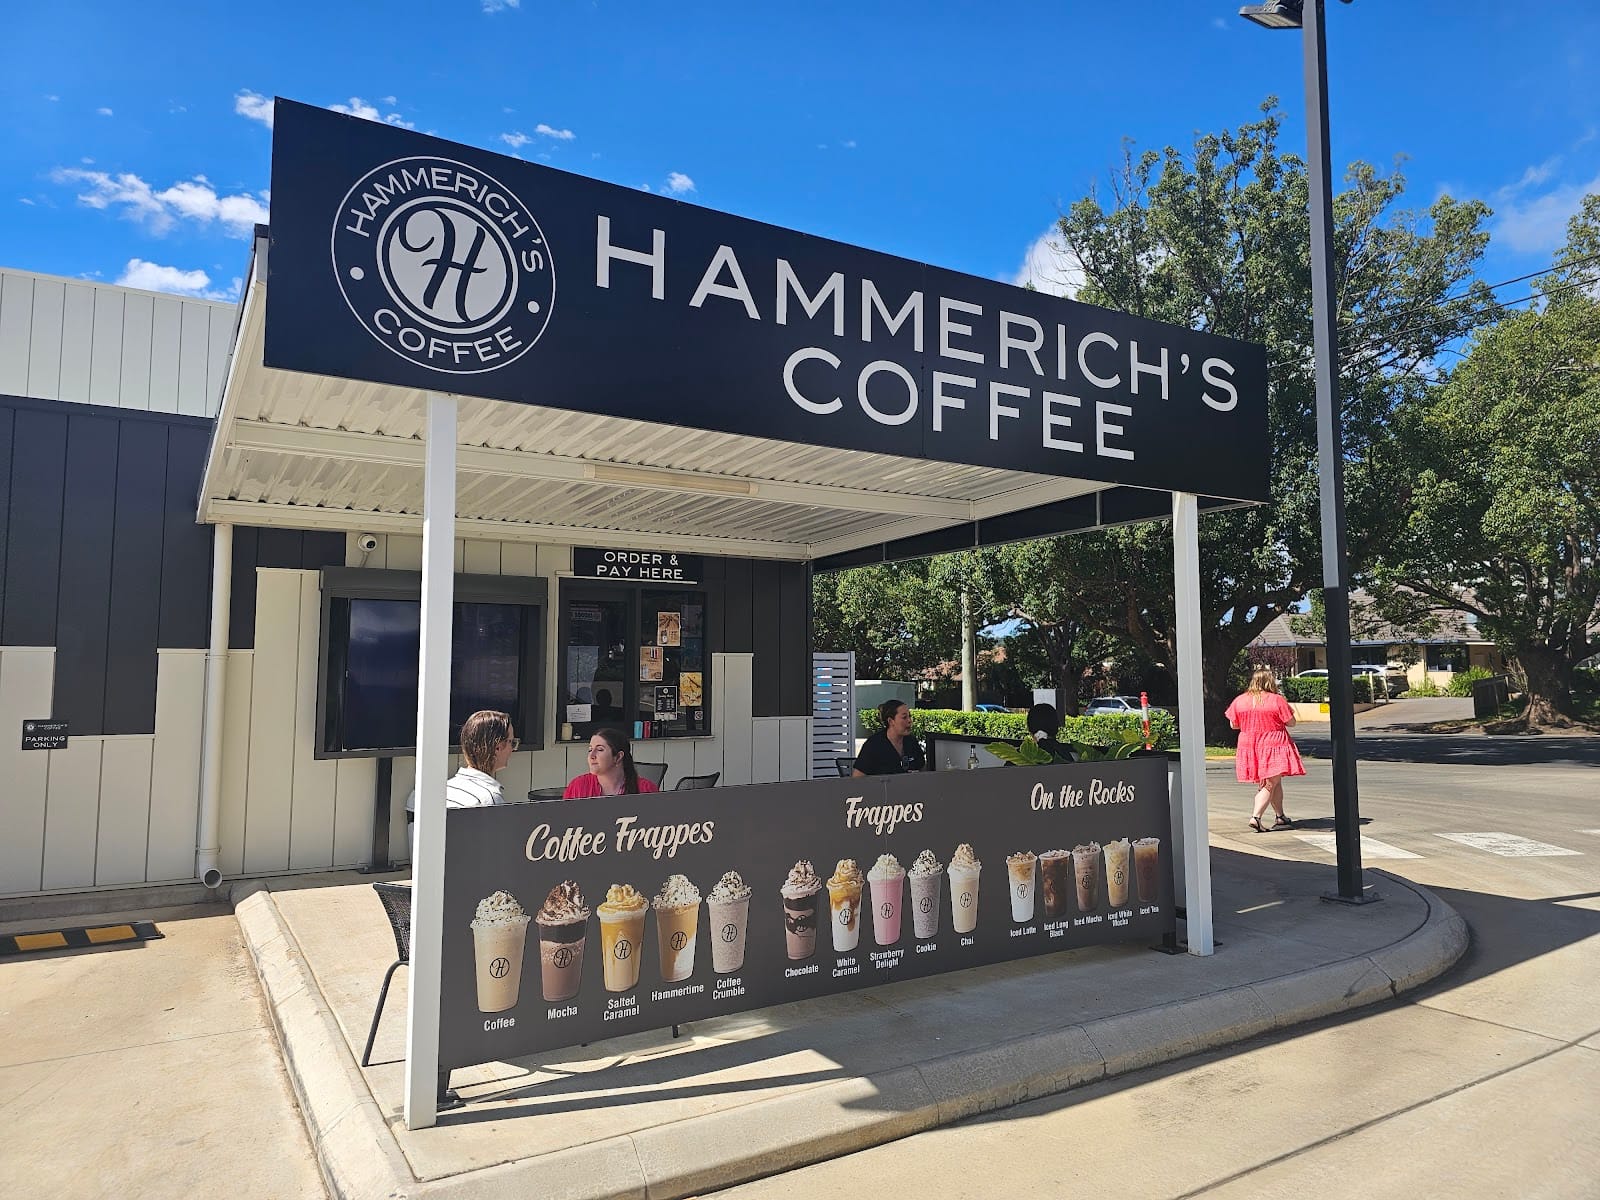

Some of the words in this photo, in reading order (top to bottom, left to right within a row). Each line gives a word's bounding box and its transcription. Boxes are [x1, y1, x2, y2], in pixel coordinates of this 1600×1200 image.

[346, 167, 544, 273] HAMMERICH'S
[596, 214, 1239, 412] HAMMERICH'S
[373, 308, 523, 364] COFFEE
[781, 346, 1136, 461] COFFEE
[604, 551, 663, 565] ORDER
[669, 554, 679, 566] &
[596, 565, 632, 577] PAY
[639, 567, 684, 580] HERE
[1030, 782, 1054, 811] On
[1059, 784, 1085, 809] the
[1088, 778, 1136, 806] Rocks
[845, 796, 924, 836] Frappes
[525, 823, 607, 863] Coffee
[615, 815, 715, 860] Frappes
[916, 943, 937, 954] Cookie
[960, 936, 974, 946] Chai
[837, 957, 856, 968] White
[870, 948, 904, 962] Strawberry
[785, 964, 819, 978] Chocolate
[875, 958, 899, 969] Delight
[832, 965, 860, 978] Caramel
[717, 977, 742, 989] Coffee
[651, 984, 705, 1001] Hammertime
[712, 986, 745, 1000] Crumble
[607, 995, 636, 1010] Salted
[547, 1006, 578, 1020] Mocha
[603, 1005, 640, 1021] Caramel
[484, 1017, 516, 1032] Coffee
